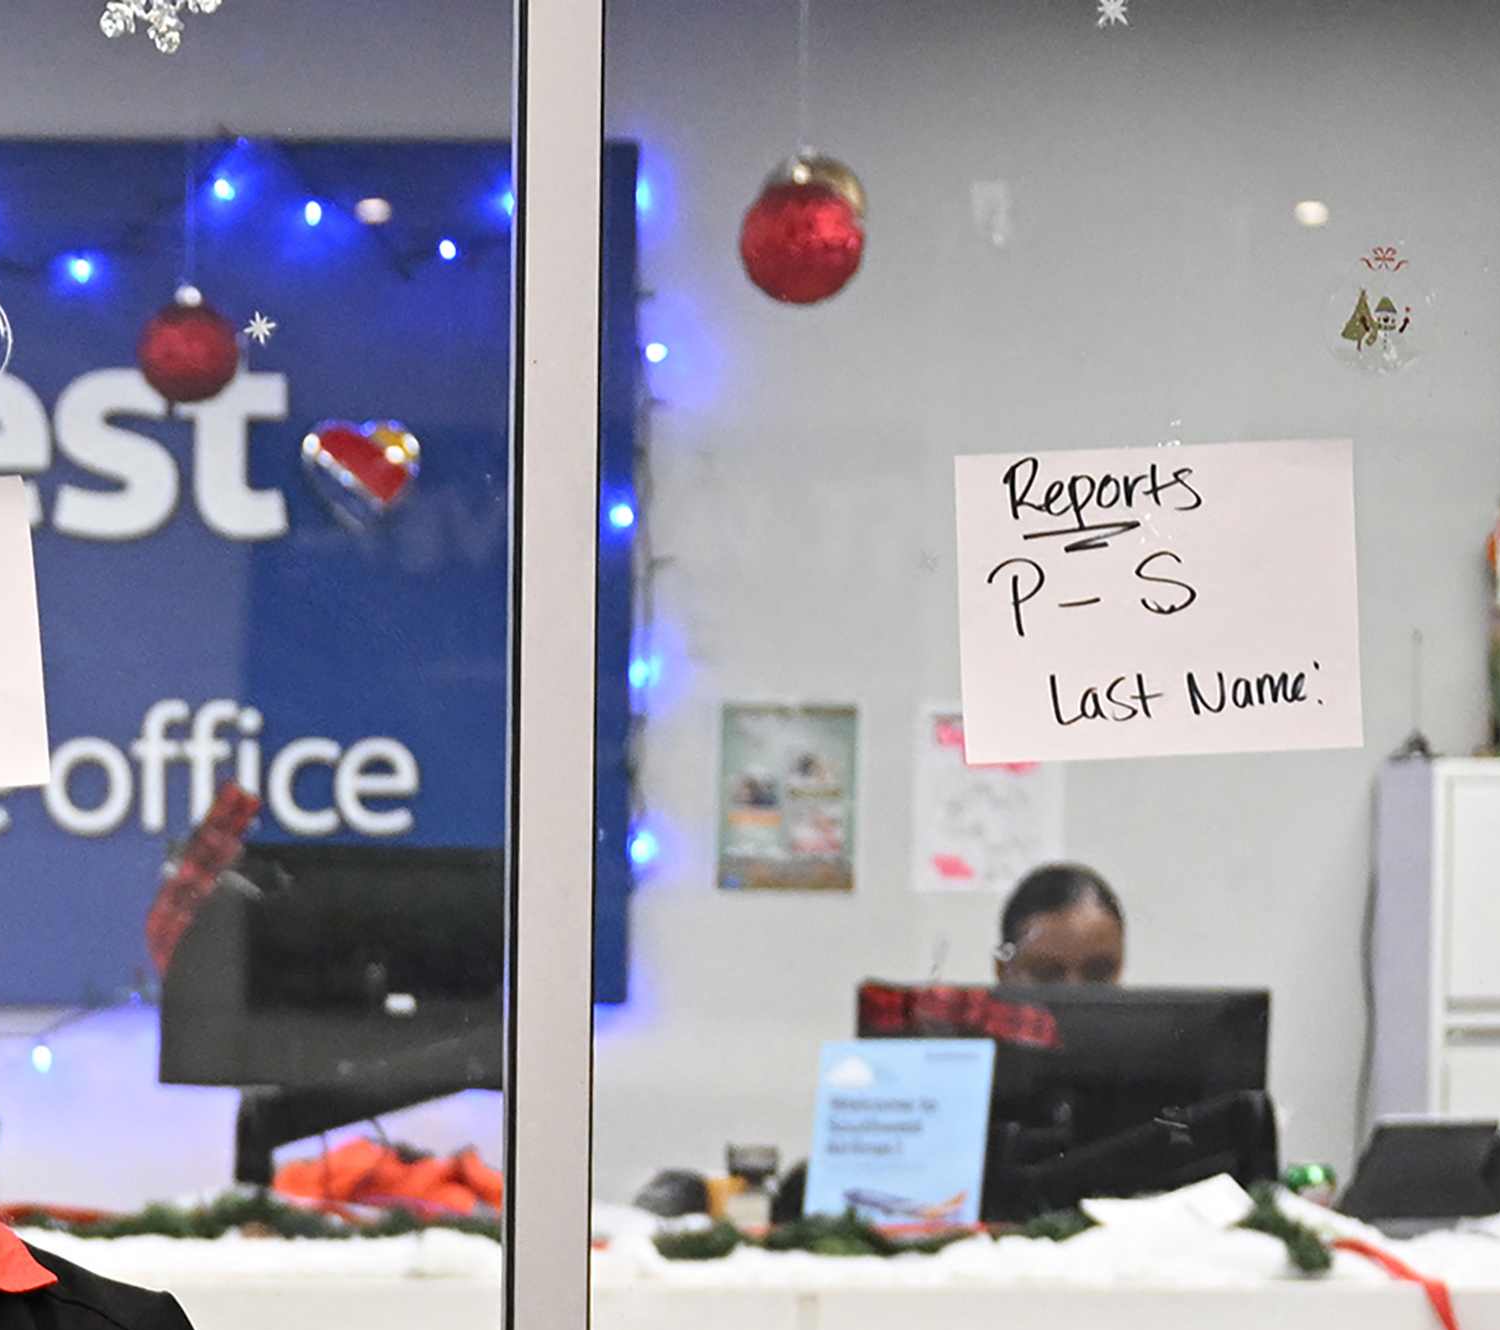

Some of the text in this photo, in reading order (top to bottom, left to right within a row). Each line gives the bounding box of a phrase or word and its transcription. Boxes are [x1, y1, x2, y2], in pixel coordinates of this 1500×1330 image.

[1003, 457, 1202, 530] Reports
[1049, 673, 1164, 725] Last
[44, 697, 420, 837] office
